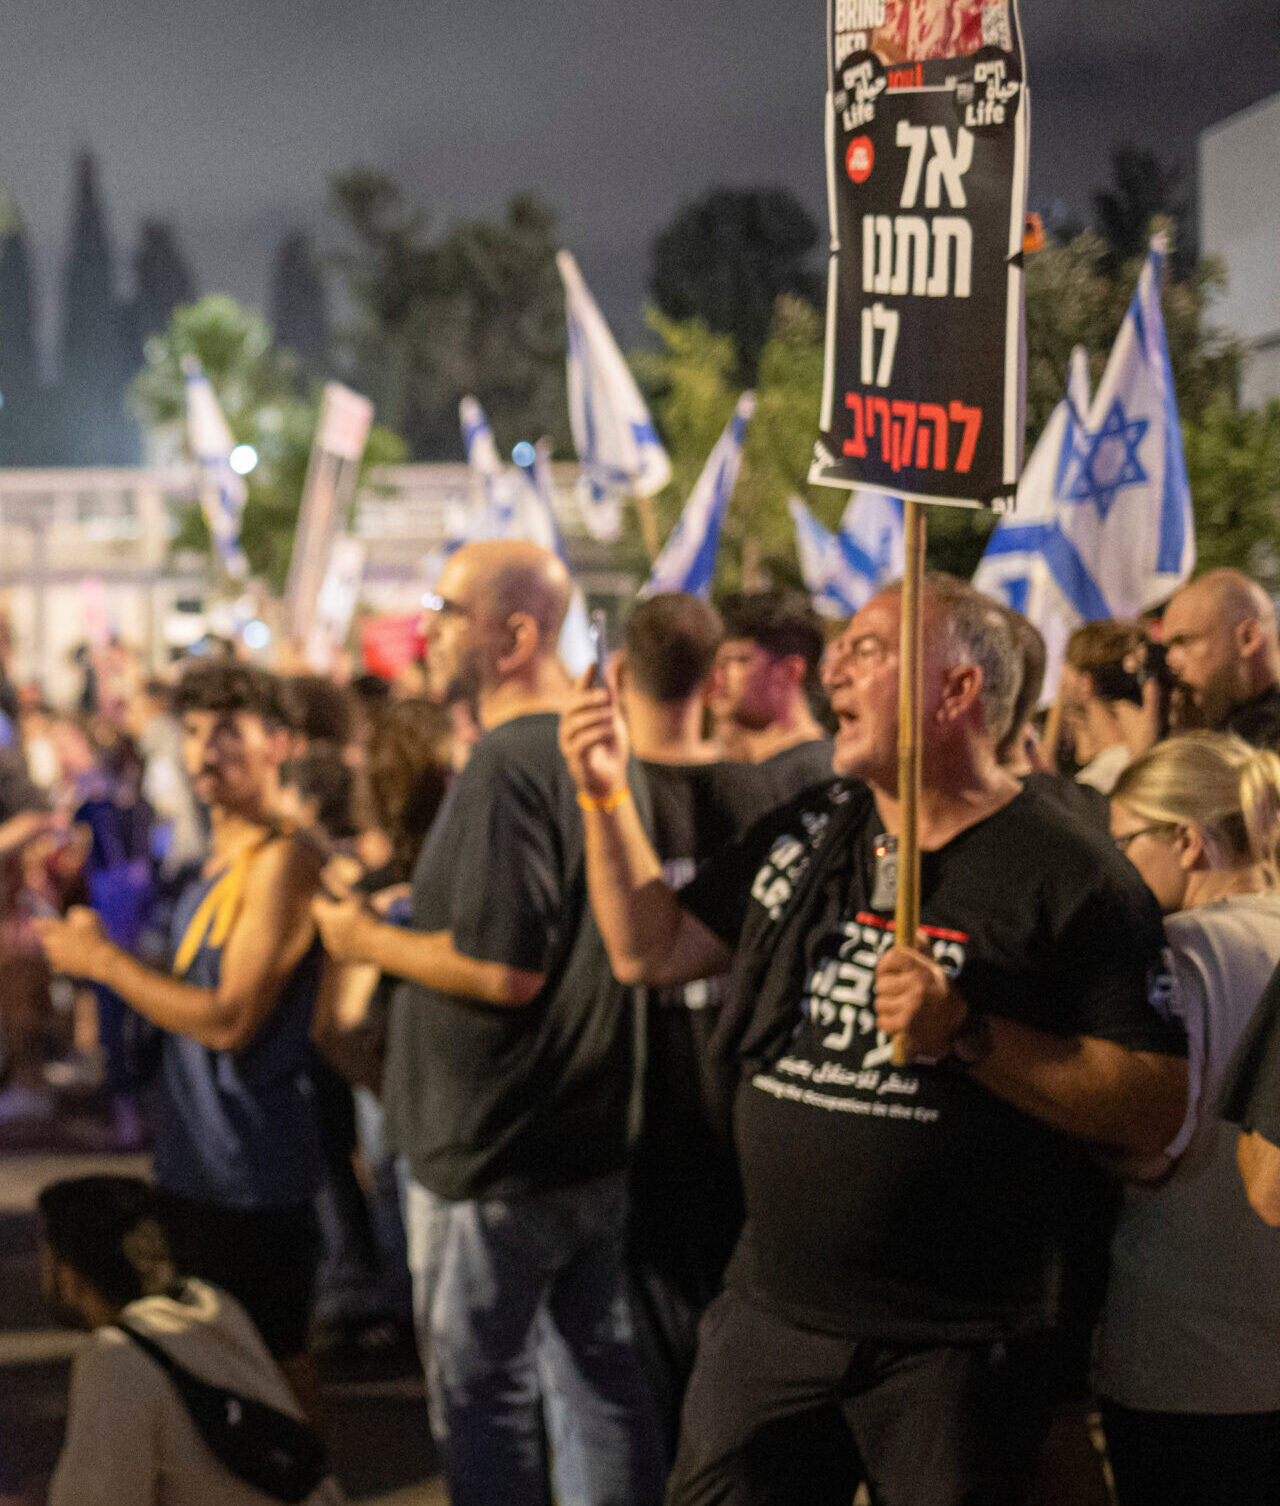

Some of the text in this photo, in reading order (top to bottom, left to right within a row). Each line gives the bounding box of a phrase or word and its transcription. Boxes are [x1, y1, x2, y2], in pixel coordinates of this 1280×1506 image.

[965, 100, 1006, 127] Life
[896, 119, 975, 208] אל
[862, 214, 973, 298] תתנו
[861, 302, 900, 388] לו
[843, 392, 982, 473] להקריב
[872, 1101, 888, 1117] in
[888, 1103, 913, 1120] the
